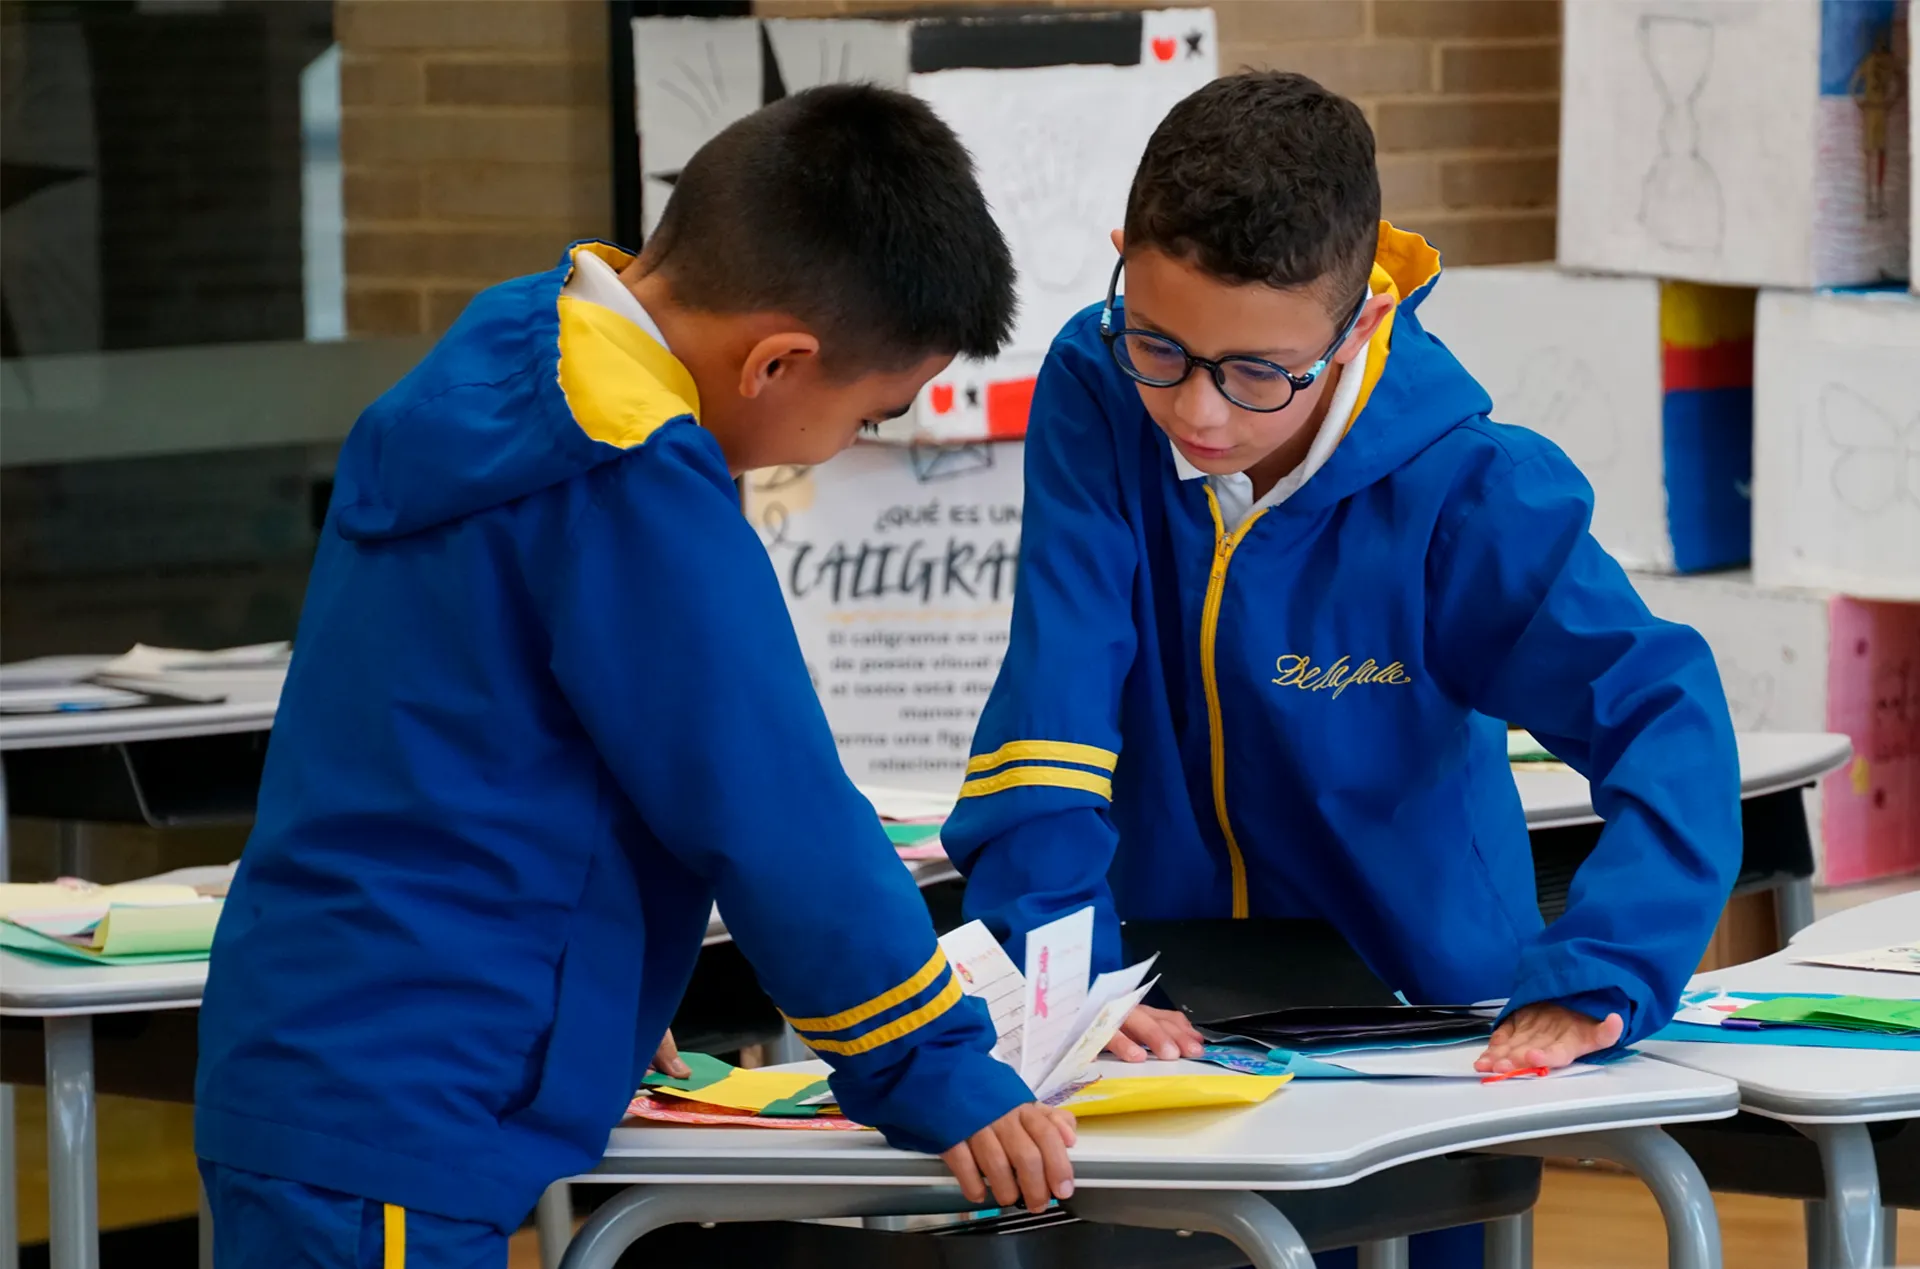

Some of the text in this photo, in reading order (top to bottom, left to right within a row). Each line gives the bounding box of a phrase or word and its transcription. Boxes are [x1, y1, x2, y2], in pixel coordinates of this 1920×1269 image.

[874, 498, 939, 532] ¿QUÉ
[949, 504, 980, 523] ES
[789, 537, 1021, 604] CALIGRA
